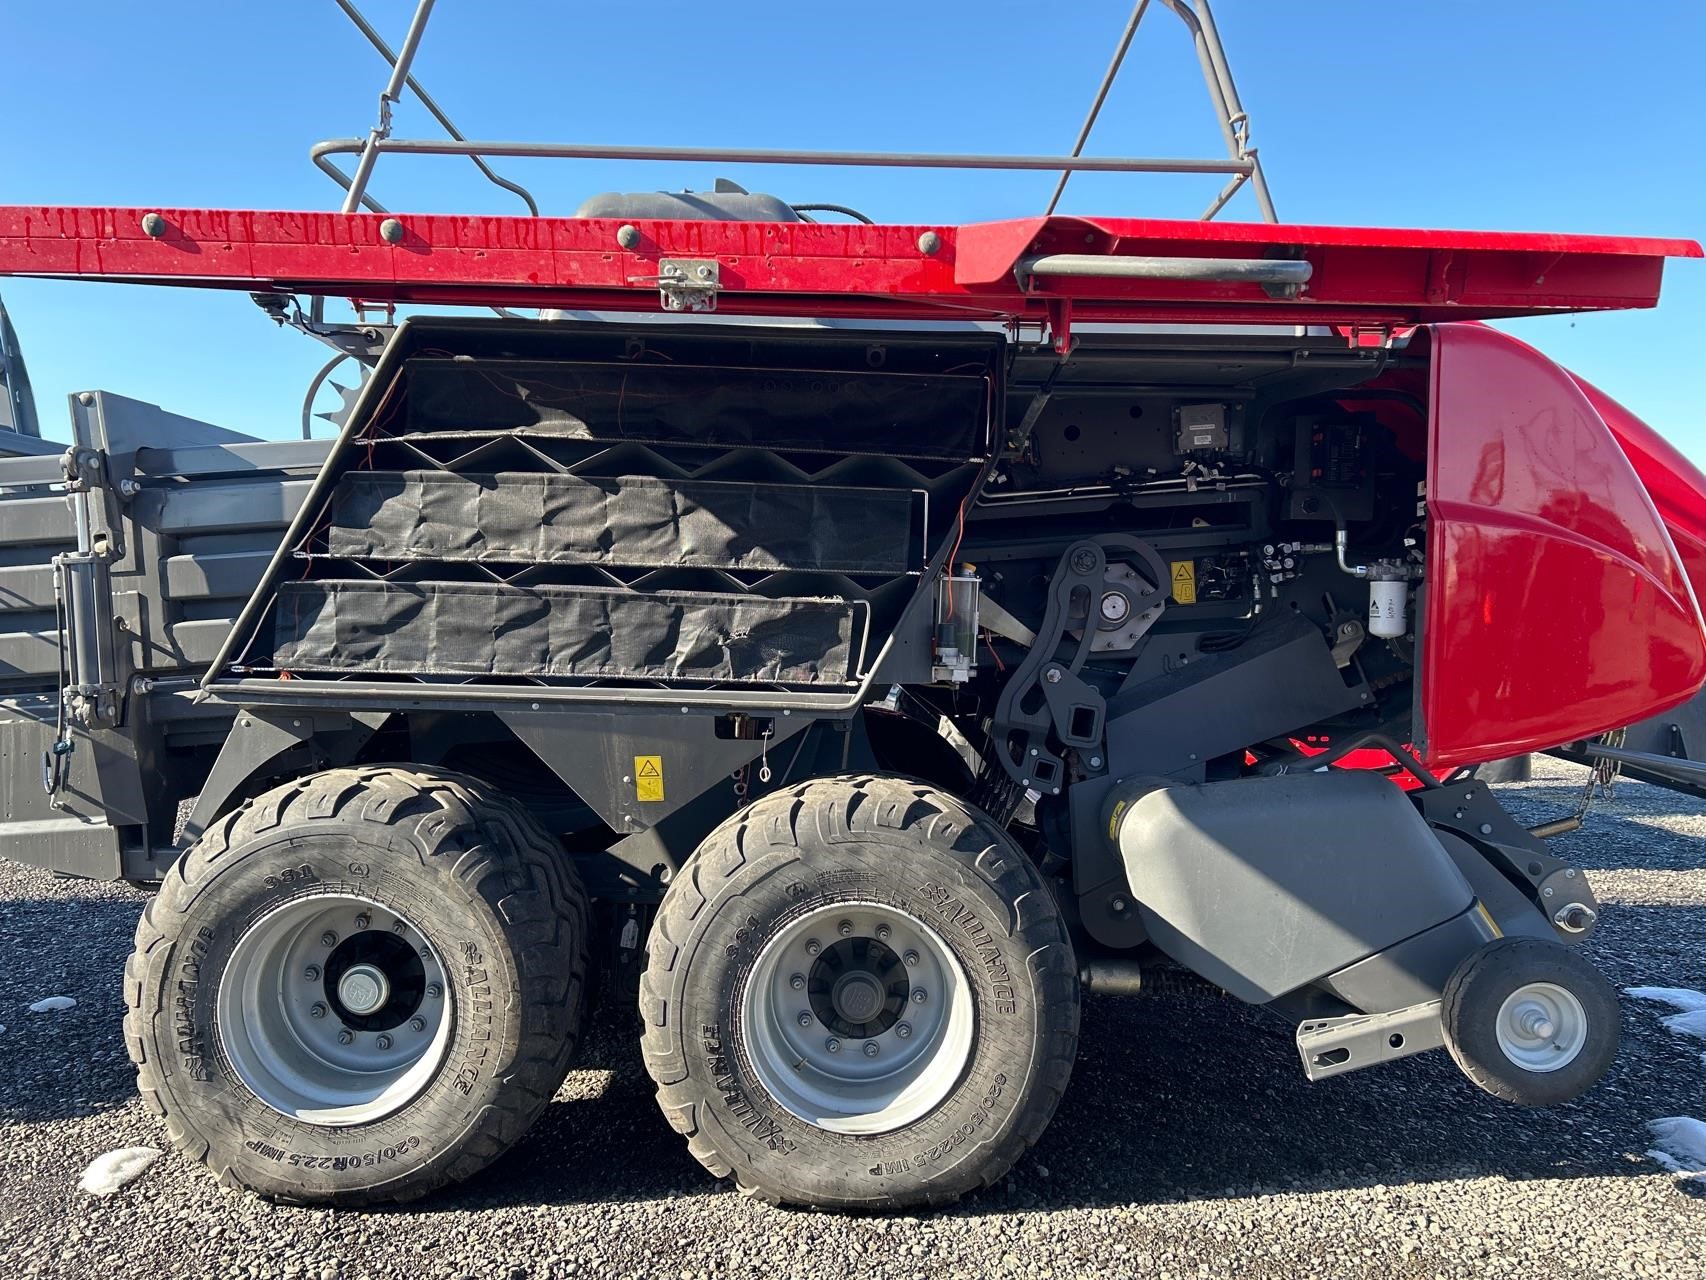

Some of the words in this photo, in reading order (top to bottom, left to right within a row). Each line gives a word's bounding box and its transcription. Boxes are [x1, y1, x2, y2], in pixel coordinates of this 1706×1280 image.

[934, 898, 1016, 1014] ALLIANCE
[452, 965, 492, 1096] ALLIANCE
[702, 1024, 783, 1140] ALLIANCE
[913, 1073, 1007, 1167] 620/50R22.5
[245, 1139, 286, 1162] IMP
[287, 1135, 420, 1171] 620/50R22.5
[868, 1158, 910, 1176] IMP
